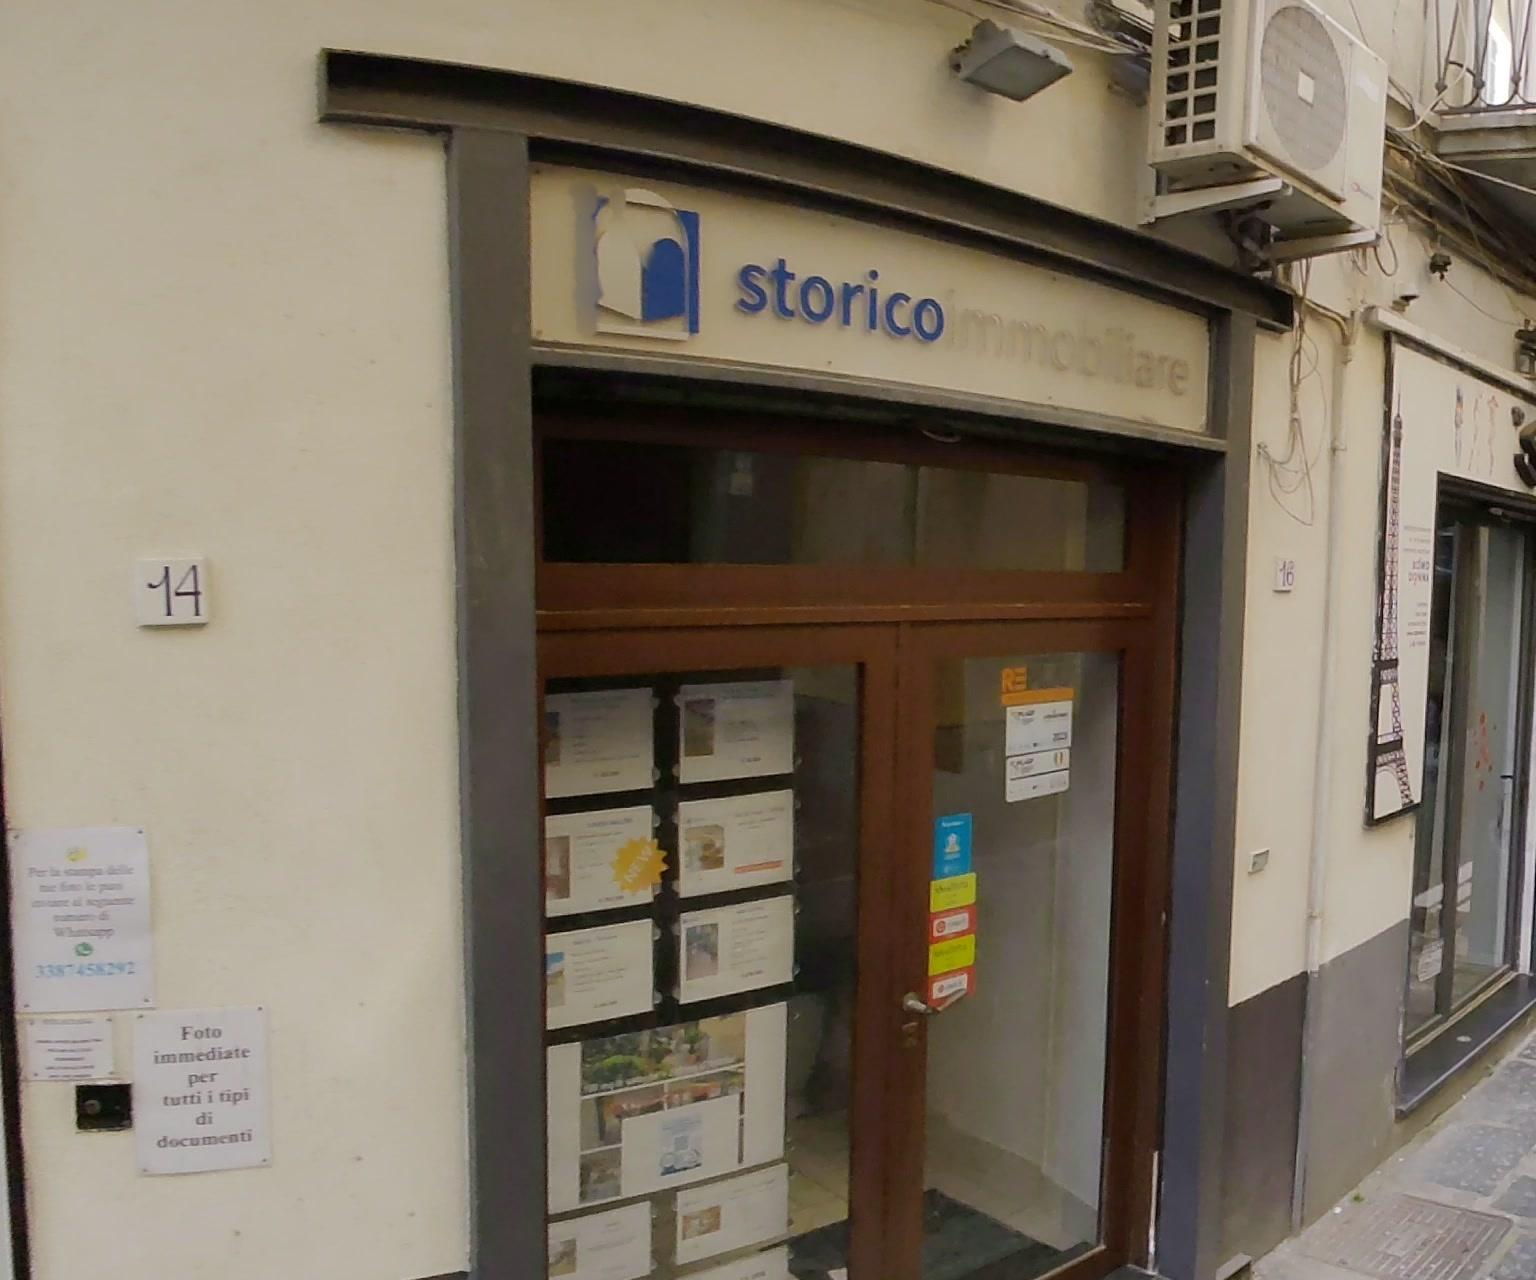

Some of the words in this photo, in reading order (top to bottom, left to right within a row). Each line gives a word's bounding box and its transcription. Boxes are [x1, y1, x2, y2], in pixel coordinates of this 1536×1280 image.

[735, 257, 946, 343] storico
[146, 564, 203, 618] 14
[181, 1025, 223, 1041] Foto
[153, 1048, 251, 1065] immediate
[188, 1072, 218, 1087] per
[163, 1091, 201, 1106] tutti
[219, 1088, 250, 1106] tipi
[195, 1113, 213, 1126] di
[157, 1129, 253, 1149] documenti
